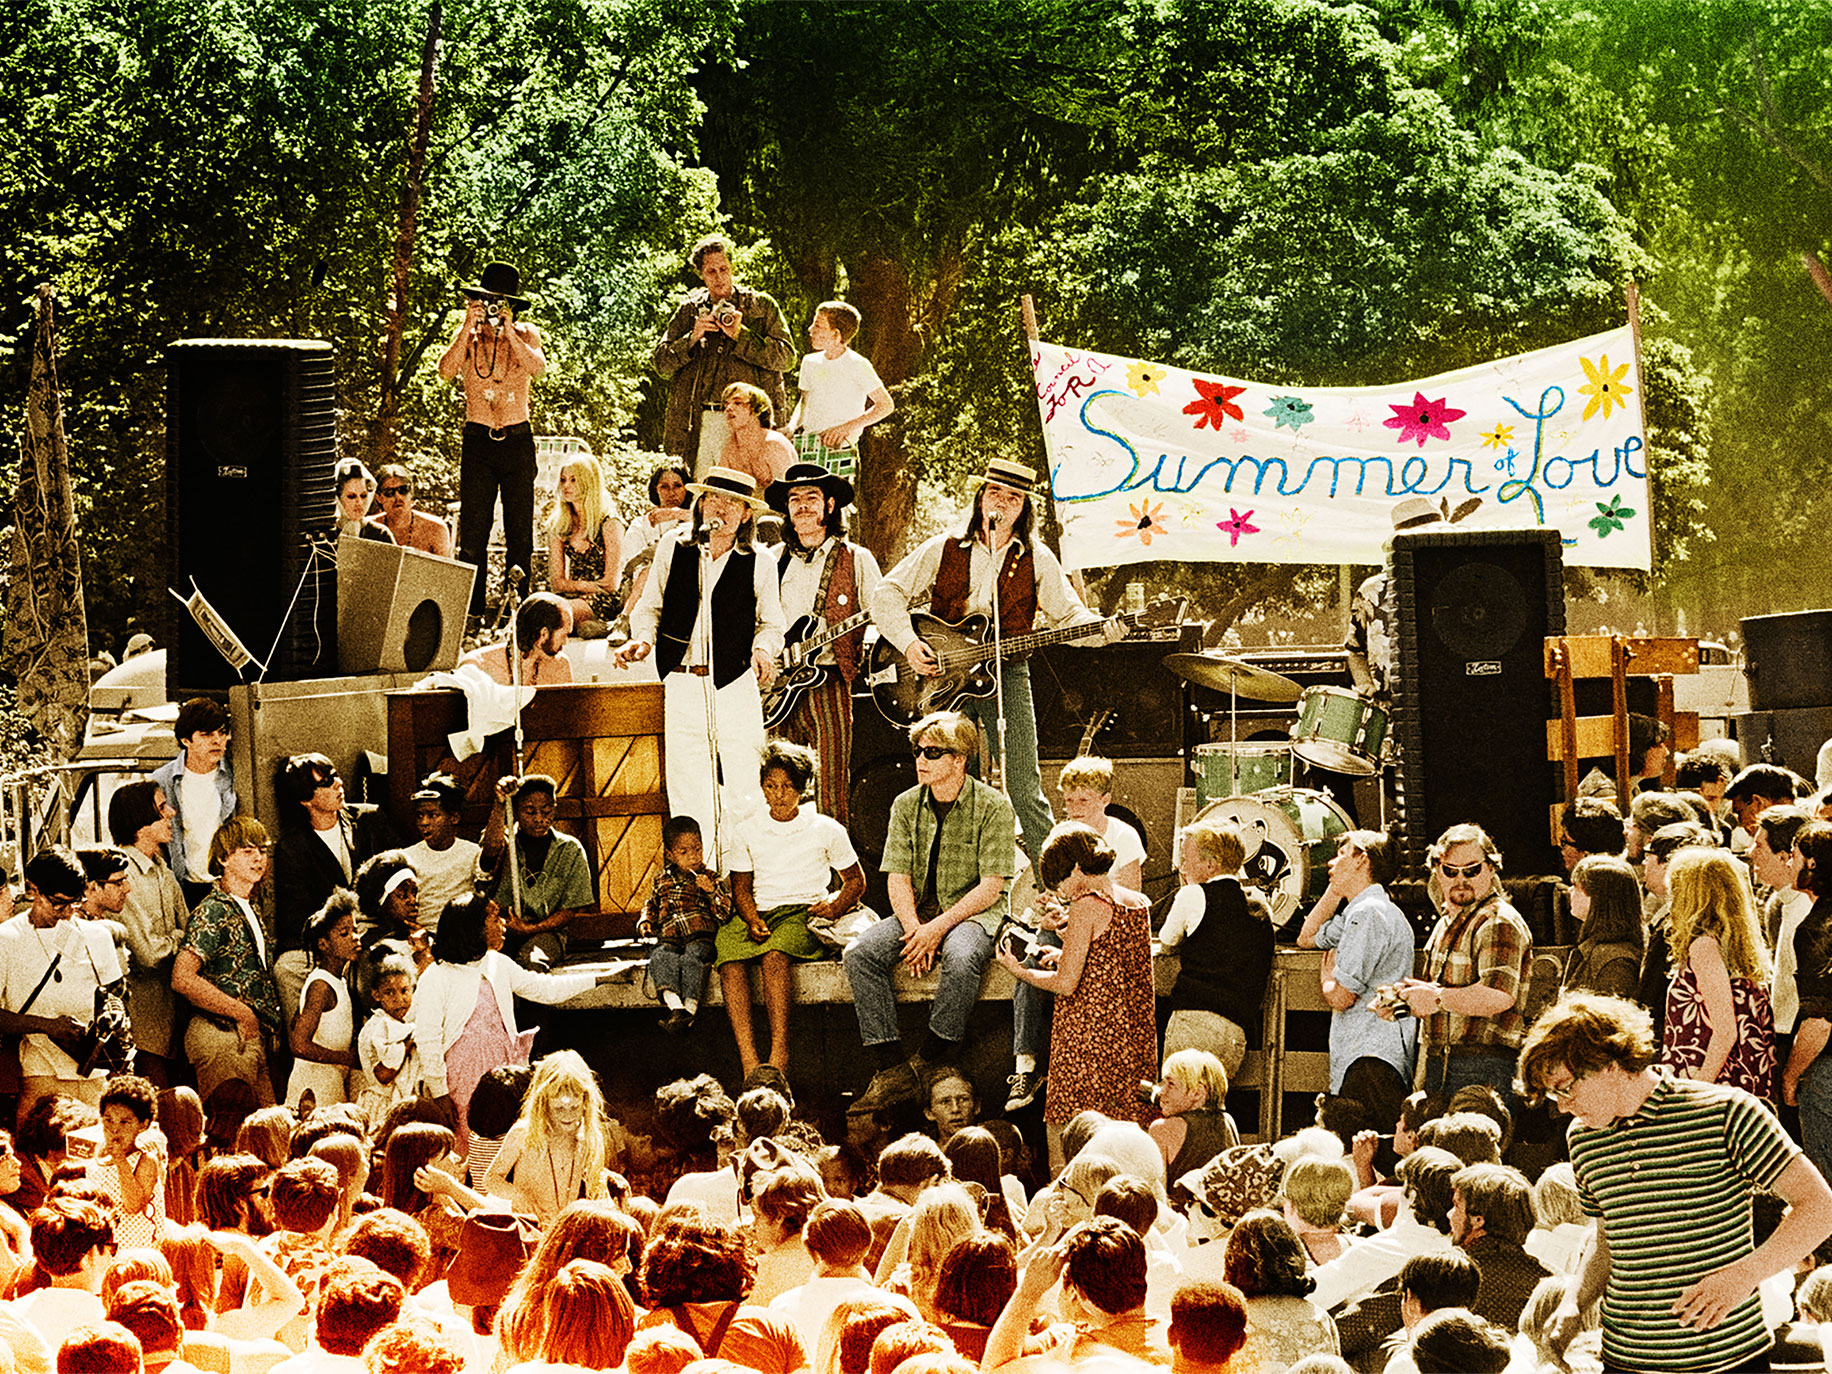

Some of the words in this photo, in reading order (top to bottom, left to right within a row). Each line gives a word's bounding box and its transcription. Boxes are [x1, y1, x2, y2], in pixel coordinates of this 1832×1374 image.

[1051, 389, 1490, 502] Summer
[1494, 446, 1520, 477] of
[1497, 386, 1647, 525] Love
